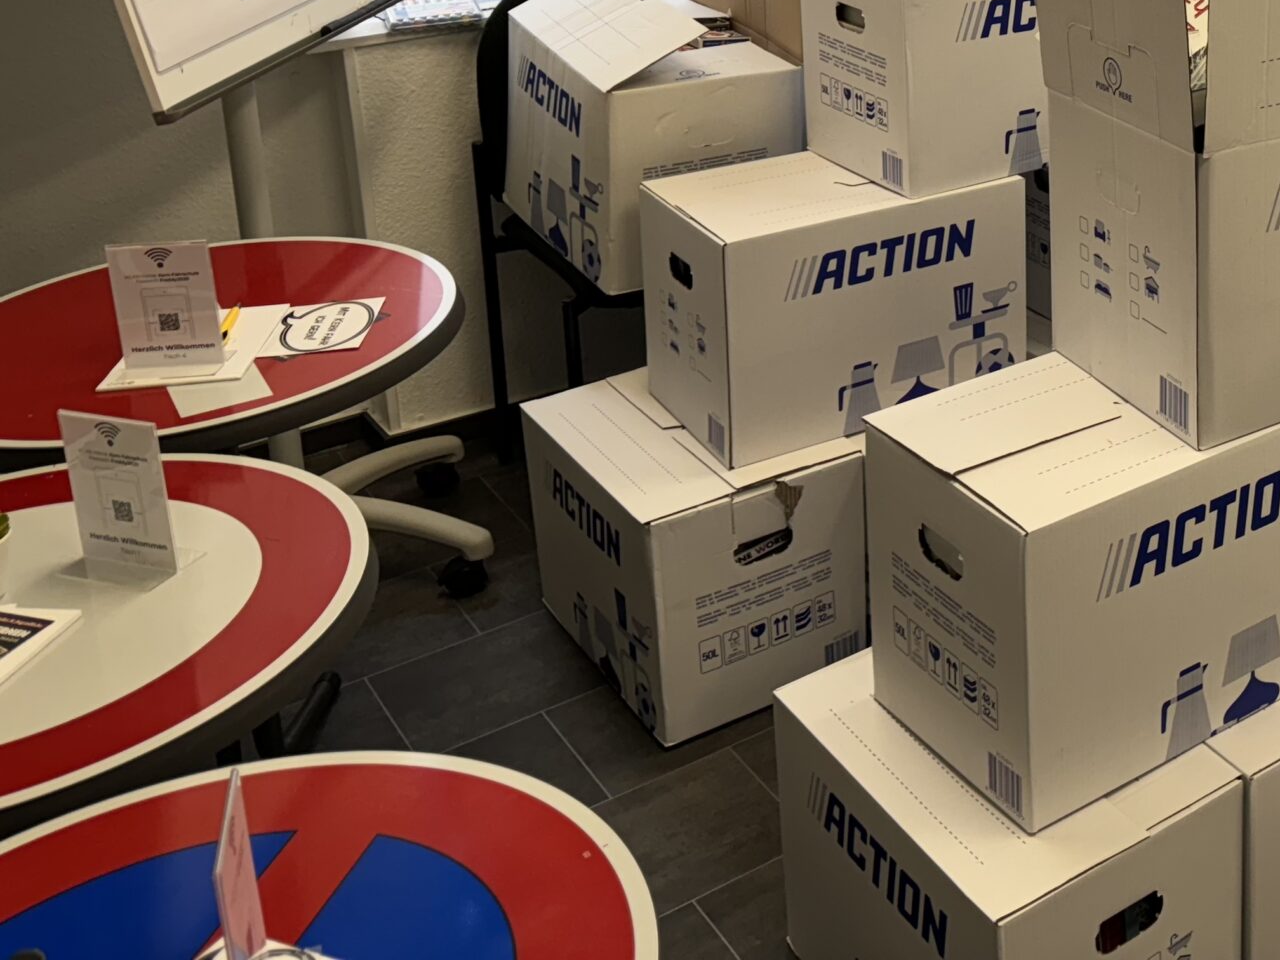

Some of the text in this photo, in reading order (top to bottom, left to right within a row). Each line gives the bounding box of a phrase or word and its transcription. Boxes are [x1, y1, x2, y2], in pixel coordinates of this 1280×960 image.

[524, 60, 582, 139] ACTION
[813, 219, 976, 296] ACTION
[131, 342, 216, 353] Herzlich Willkommen
[89, 532, 169, 551] Herzlich Willkommen
[553, 468, 621, 568] ACTION
[702, 648, 719, 662] 50L
[824, 791, 949, 958] ACTION
